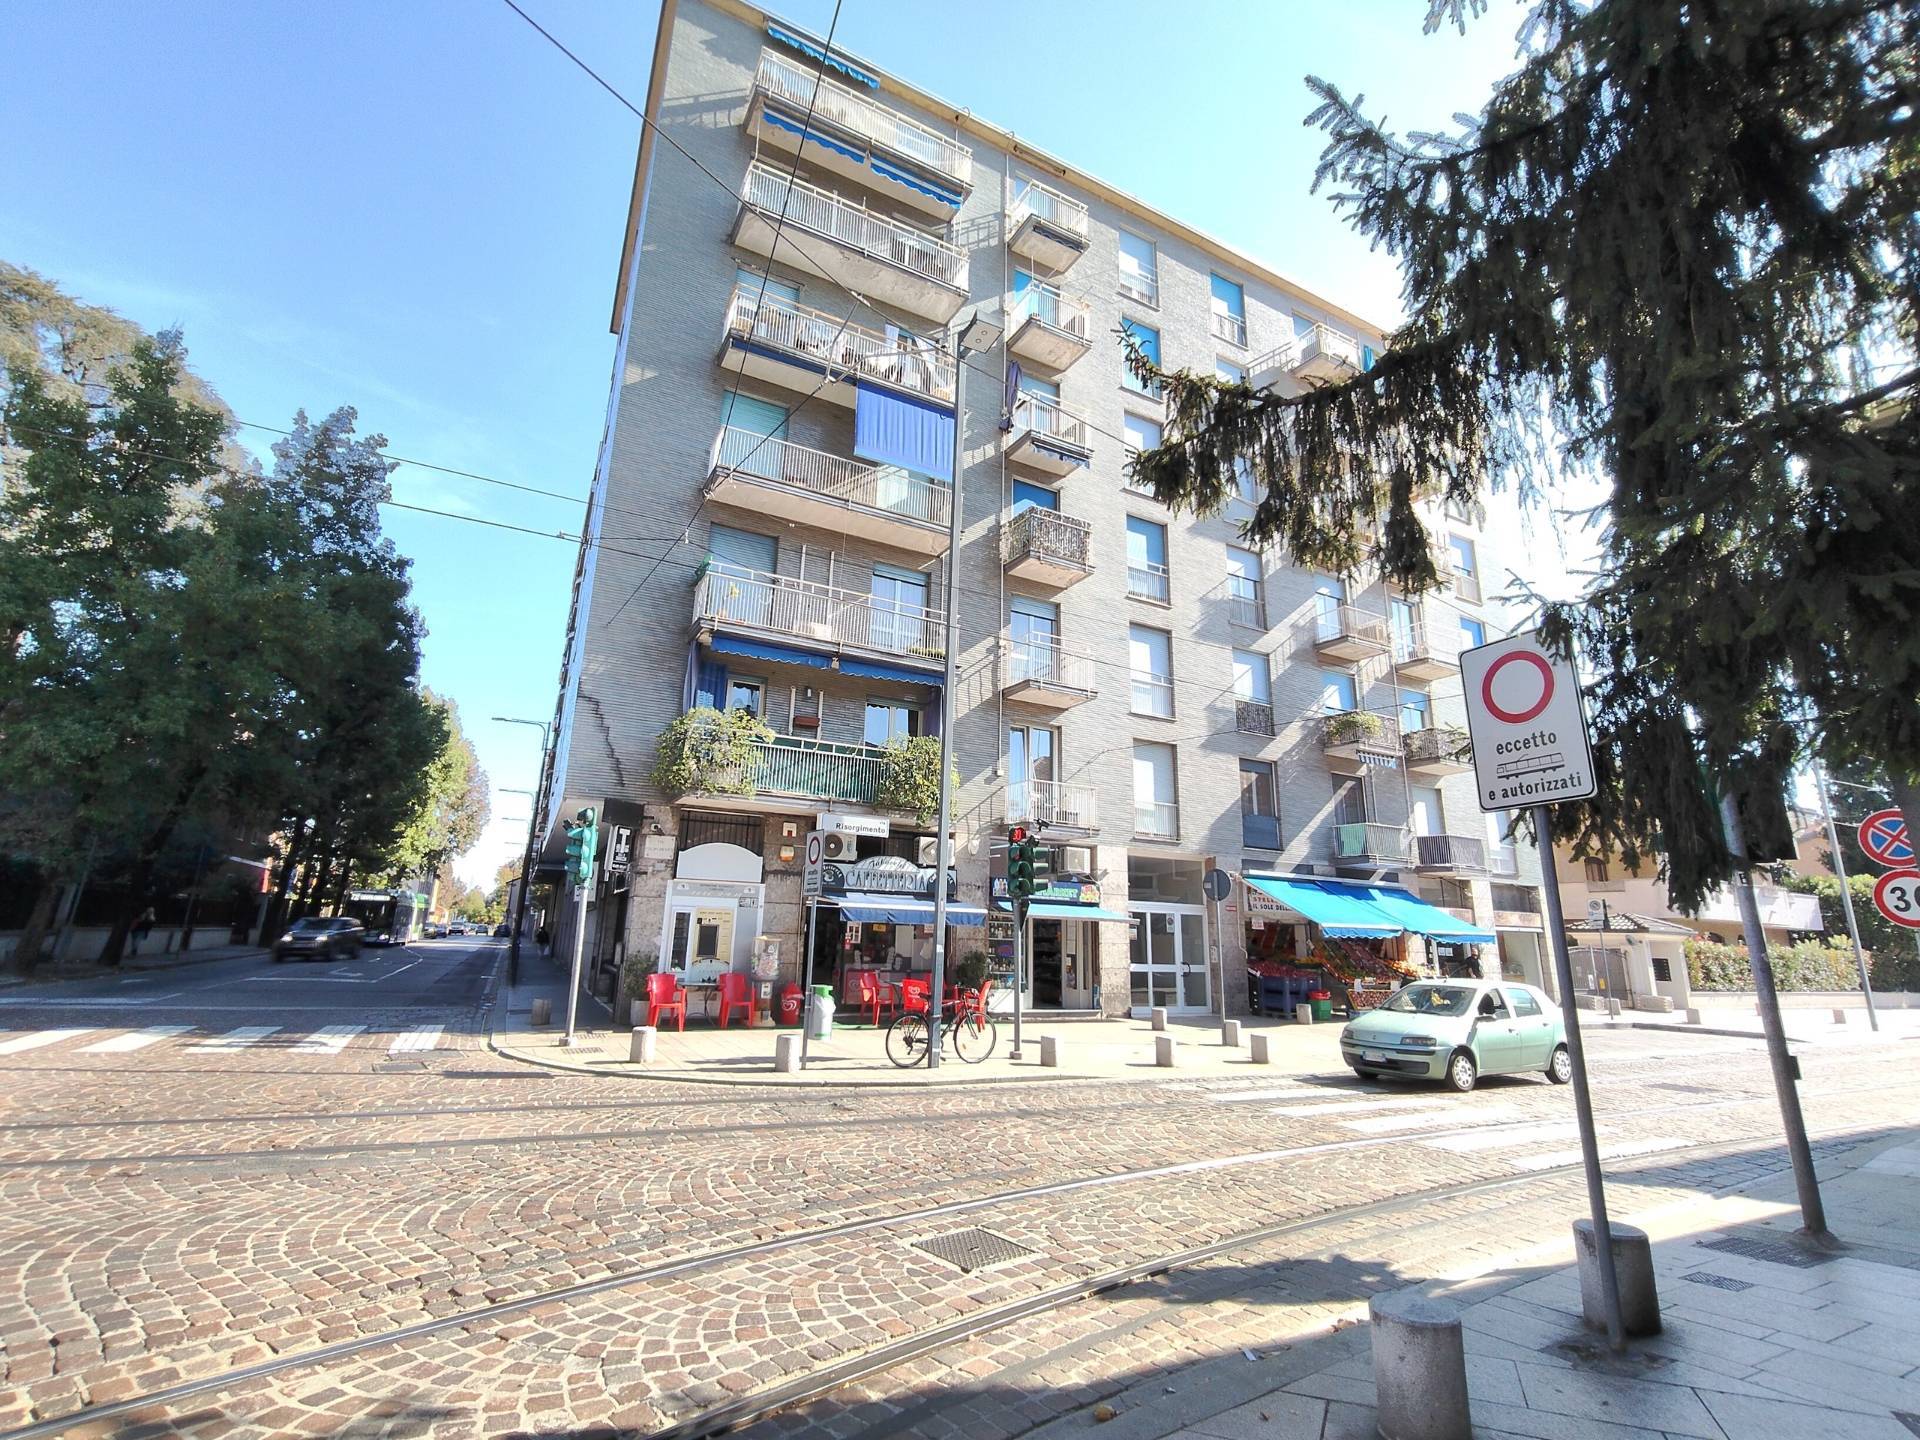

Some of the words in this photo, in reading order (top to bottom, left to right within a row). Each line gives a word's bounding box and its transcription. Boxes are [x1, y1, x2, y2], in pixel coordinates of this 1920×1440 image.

[1496, 731, 1556, 754] eccetto
[1489, 790, 1496, 800] e
[1501, 771, 1582, 799] autorizzati
[835, 822, 886, 833] Risorgimento
[845, 870, 927, 891] CAFFETTERIA
